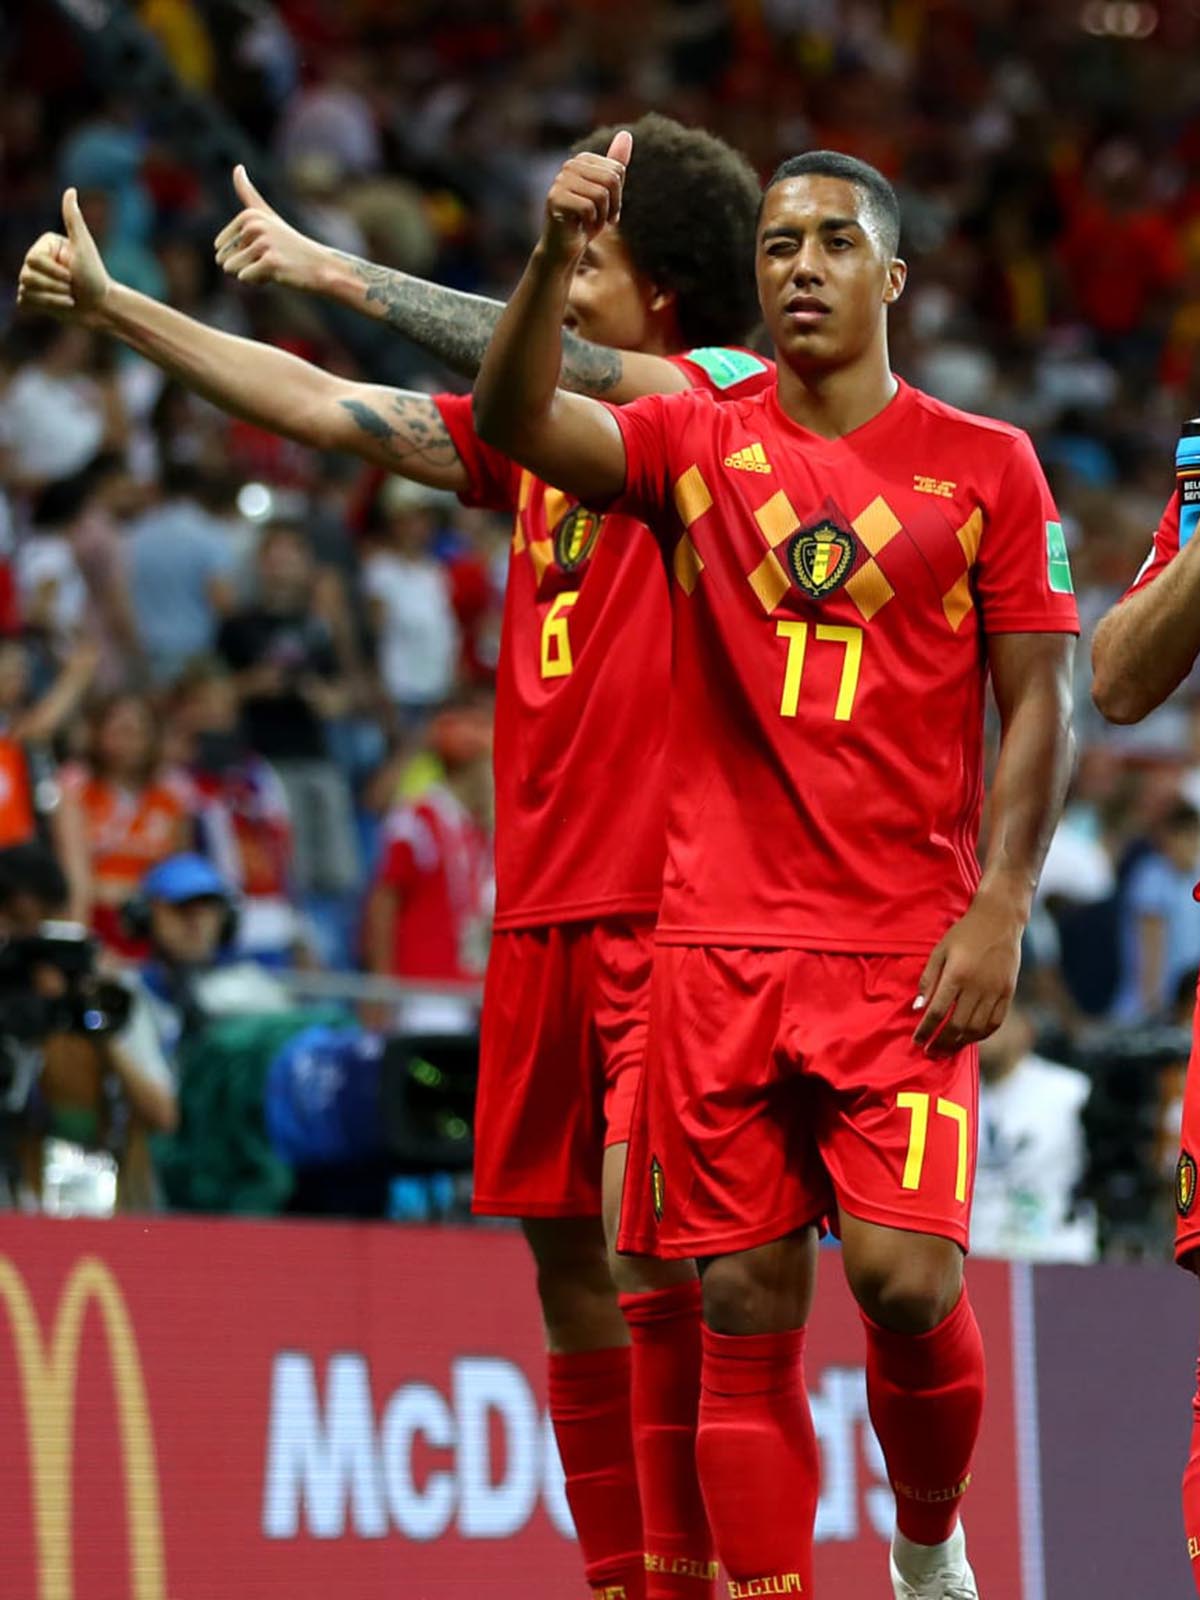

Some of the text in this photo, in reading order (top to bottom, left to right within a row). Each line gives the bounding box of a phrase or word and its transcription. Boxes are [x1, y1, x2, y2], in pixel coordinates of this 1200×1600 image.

[541, 591, 580, 679] 6
[776, 620, 863, 721] 17
[896, 1091, 968, 1203] 17
